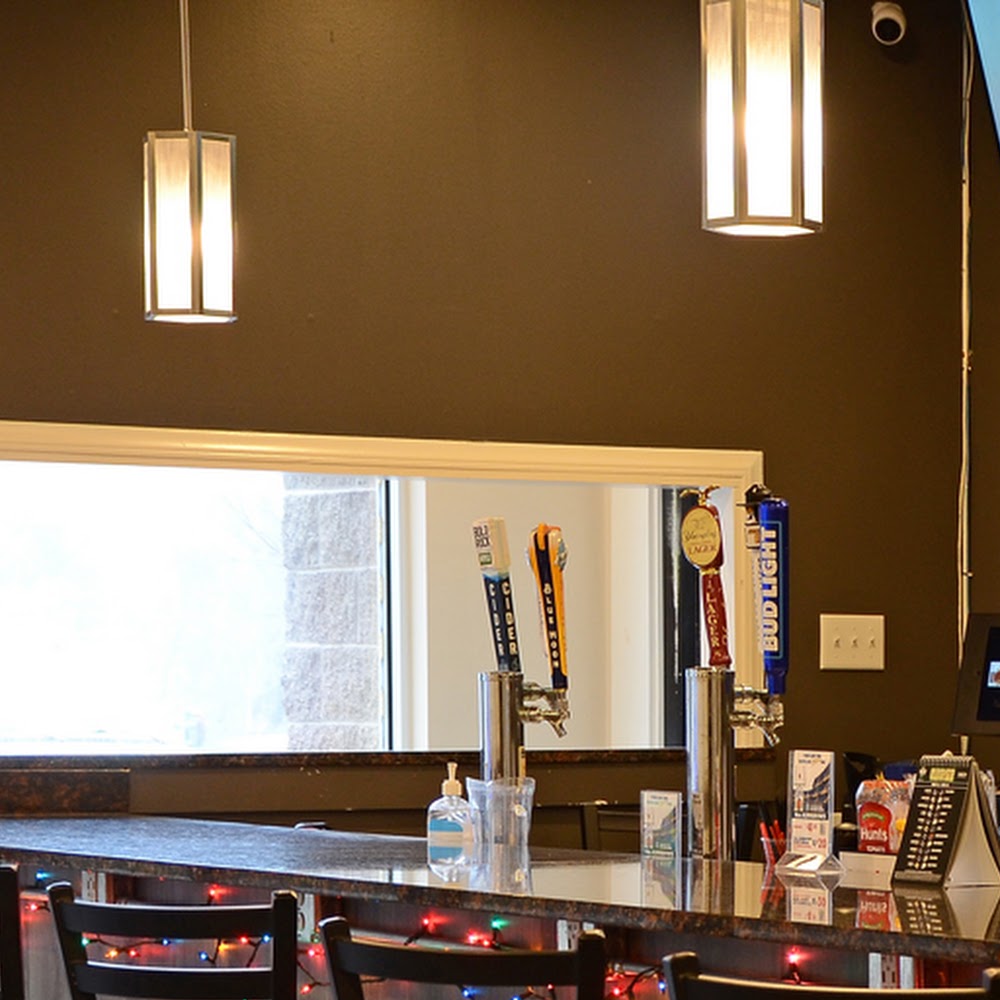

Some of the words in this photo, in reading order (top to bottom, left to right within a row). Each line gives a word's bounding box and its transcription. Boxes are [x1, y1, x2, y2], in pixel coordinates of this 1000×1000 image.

[761, 526, 779, 599] LIGHT
[488, 582, 505, 656] CIDER
[501, 580, 519, 656] CIDER
[542, 583, 555, 625] BLUE
[549, 630, 560, 669] MOON
[705, 591, 720, 648] LAGER
[762, 603, 779, 652] BUD
